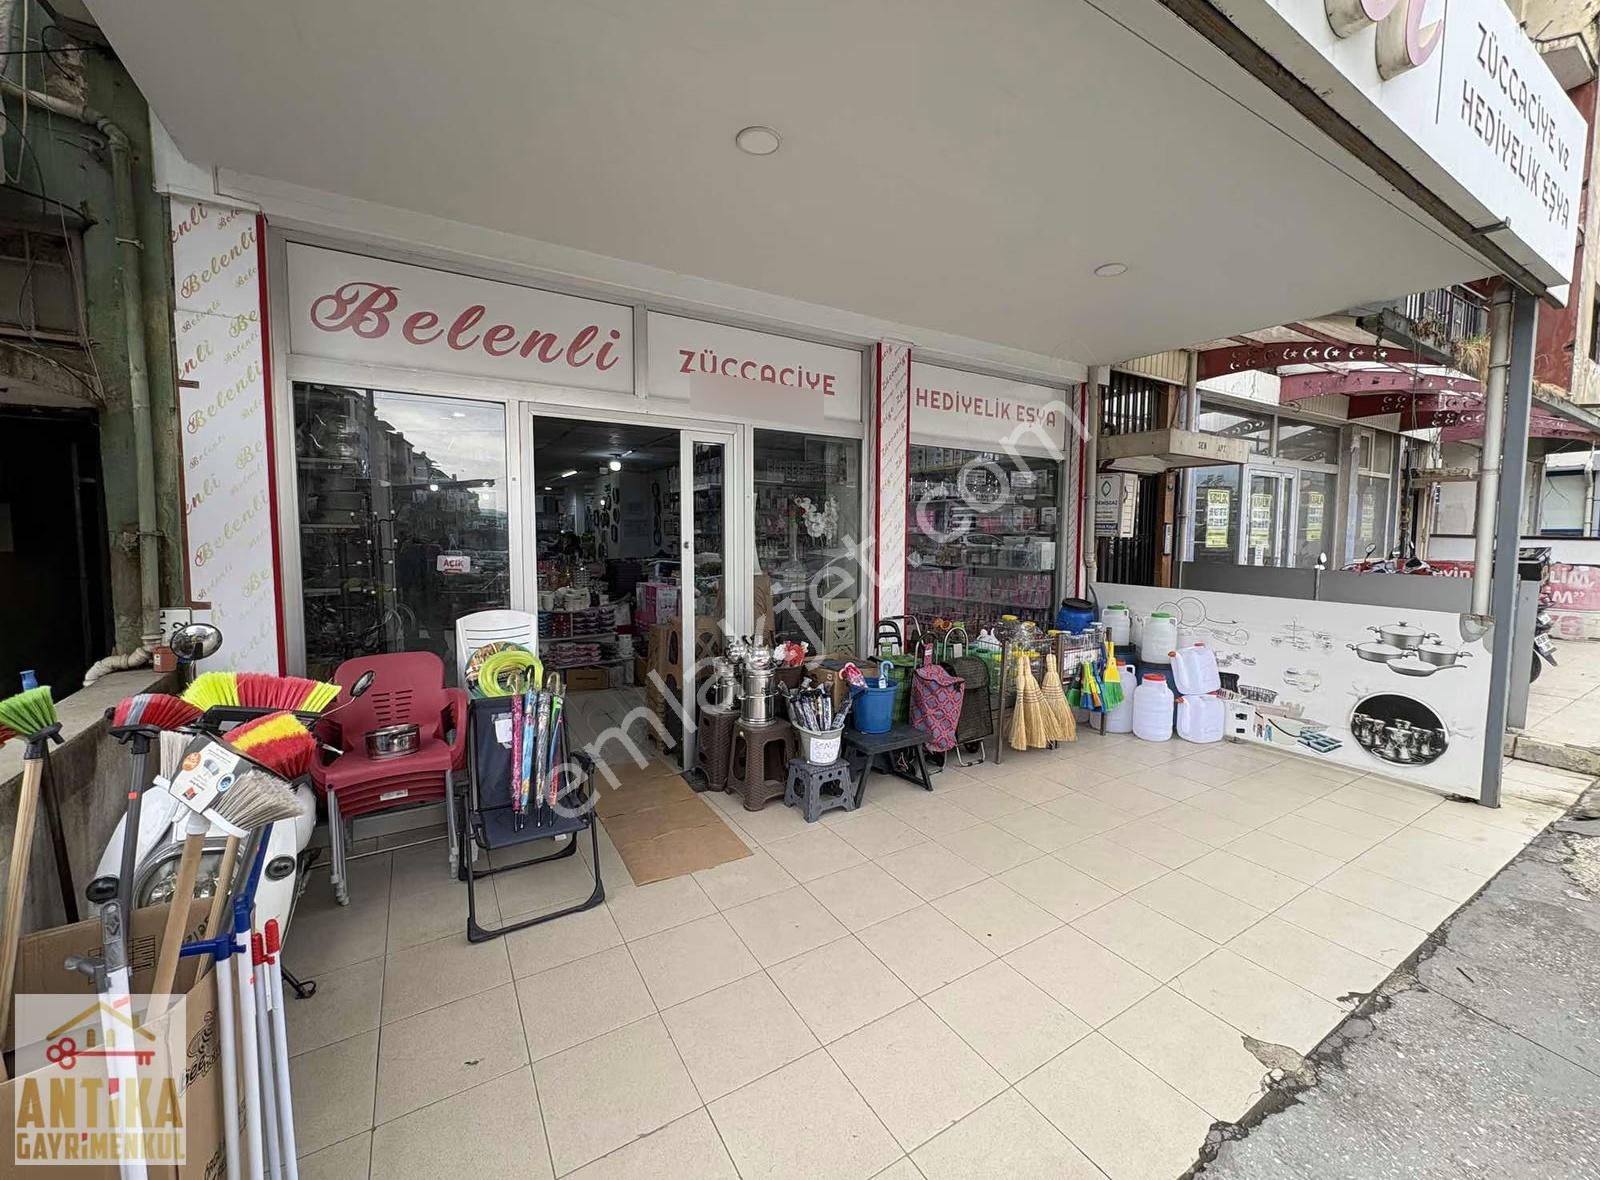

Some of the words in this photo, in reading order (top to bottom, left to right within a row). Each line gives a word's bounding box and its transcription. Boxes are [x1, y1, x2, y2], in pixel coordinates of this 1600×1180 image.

[1477, 22, 1556, 153] ZÜCCACİYE
[1461, 79, 1541, 198] HEDİYELİK
[1542, 171, 1570, 230] EŞYA
[181, 226, 257, 299] Belenli
[310, 281, 621, 371] Belenli
[187, 360, 263, 432] Belenli
[679, 349, 836, 396] ZÜCCACİYE
[916, 387, 1011, 421] HEDİYELİK
[1016, 404, 1056, 428] EŞYA
